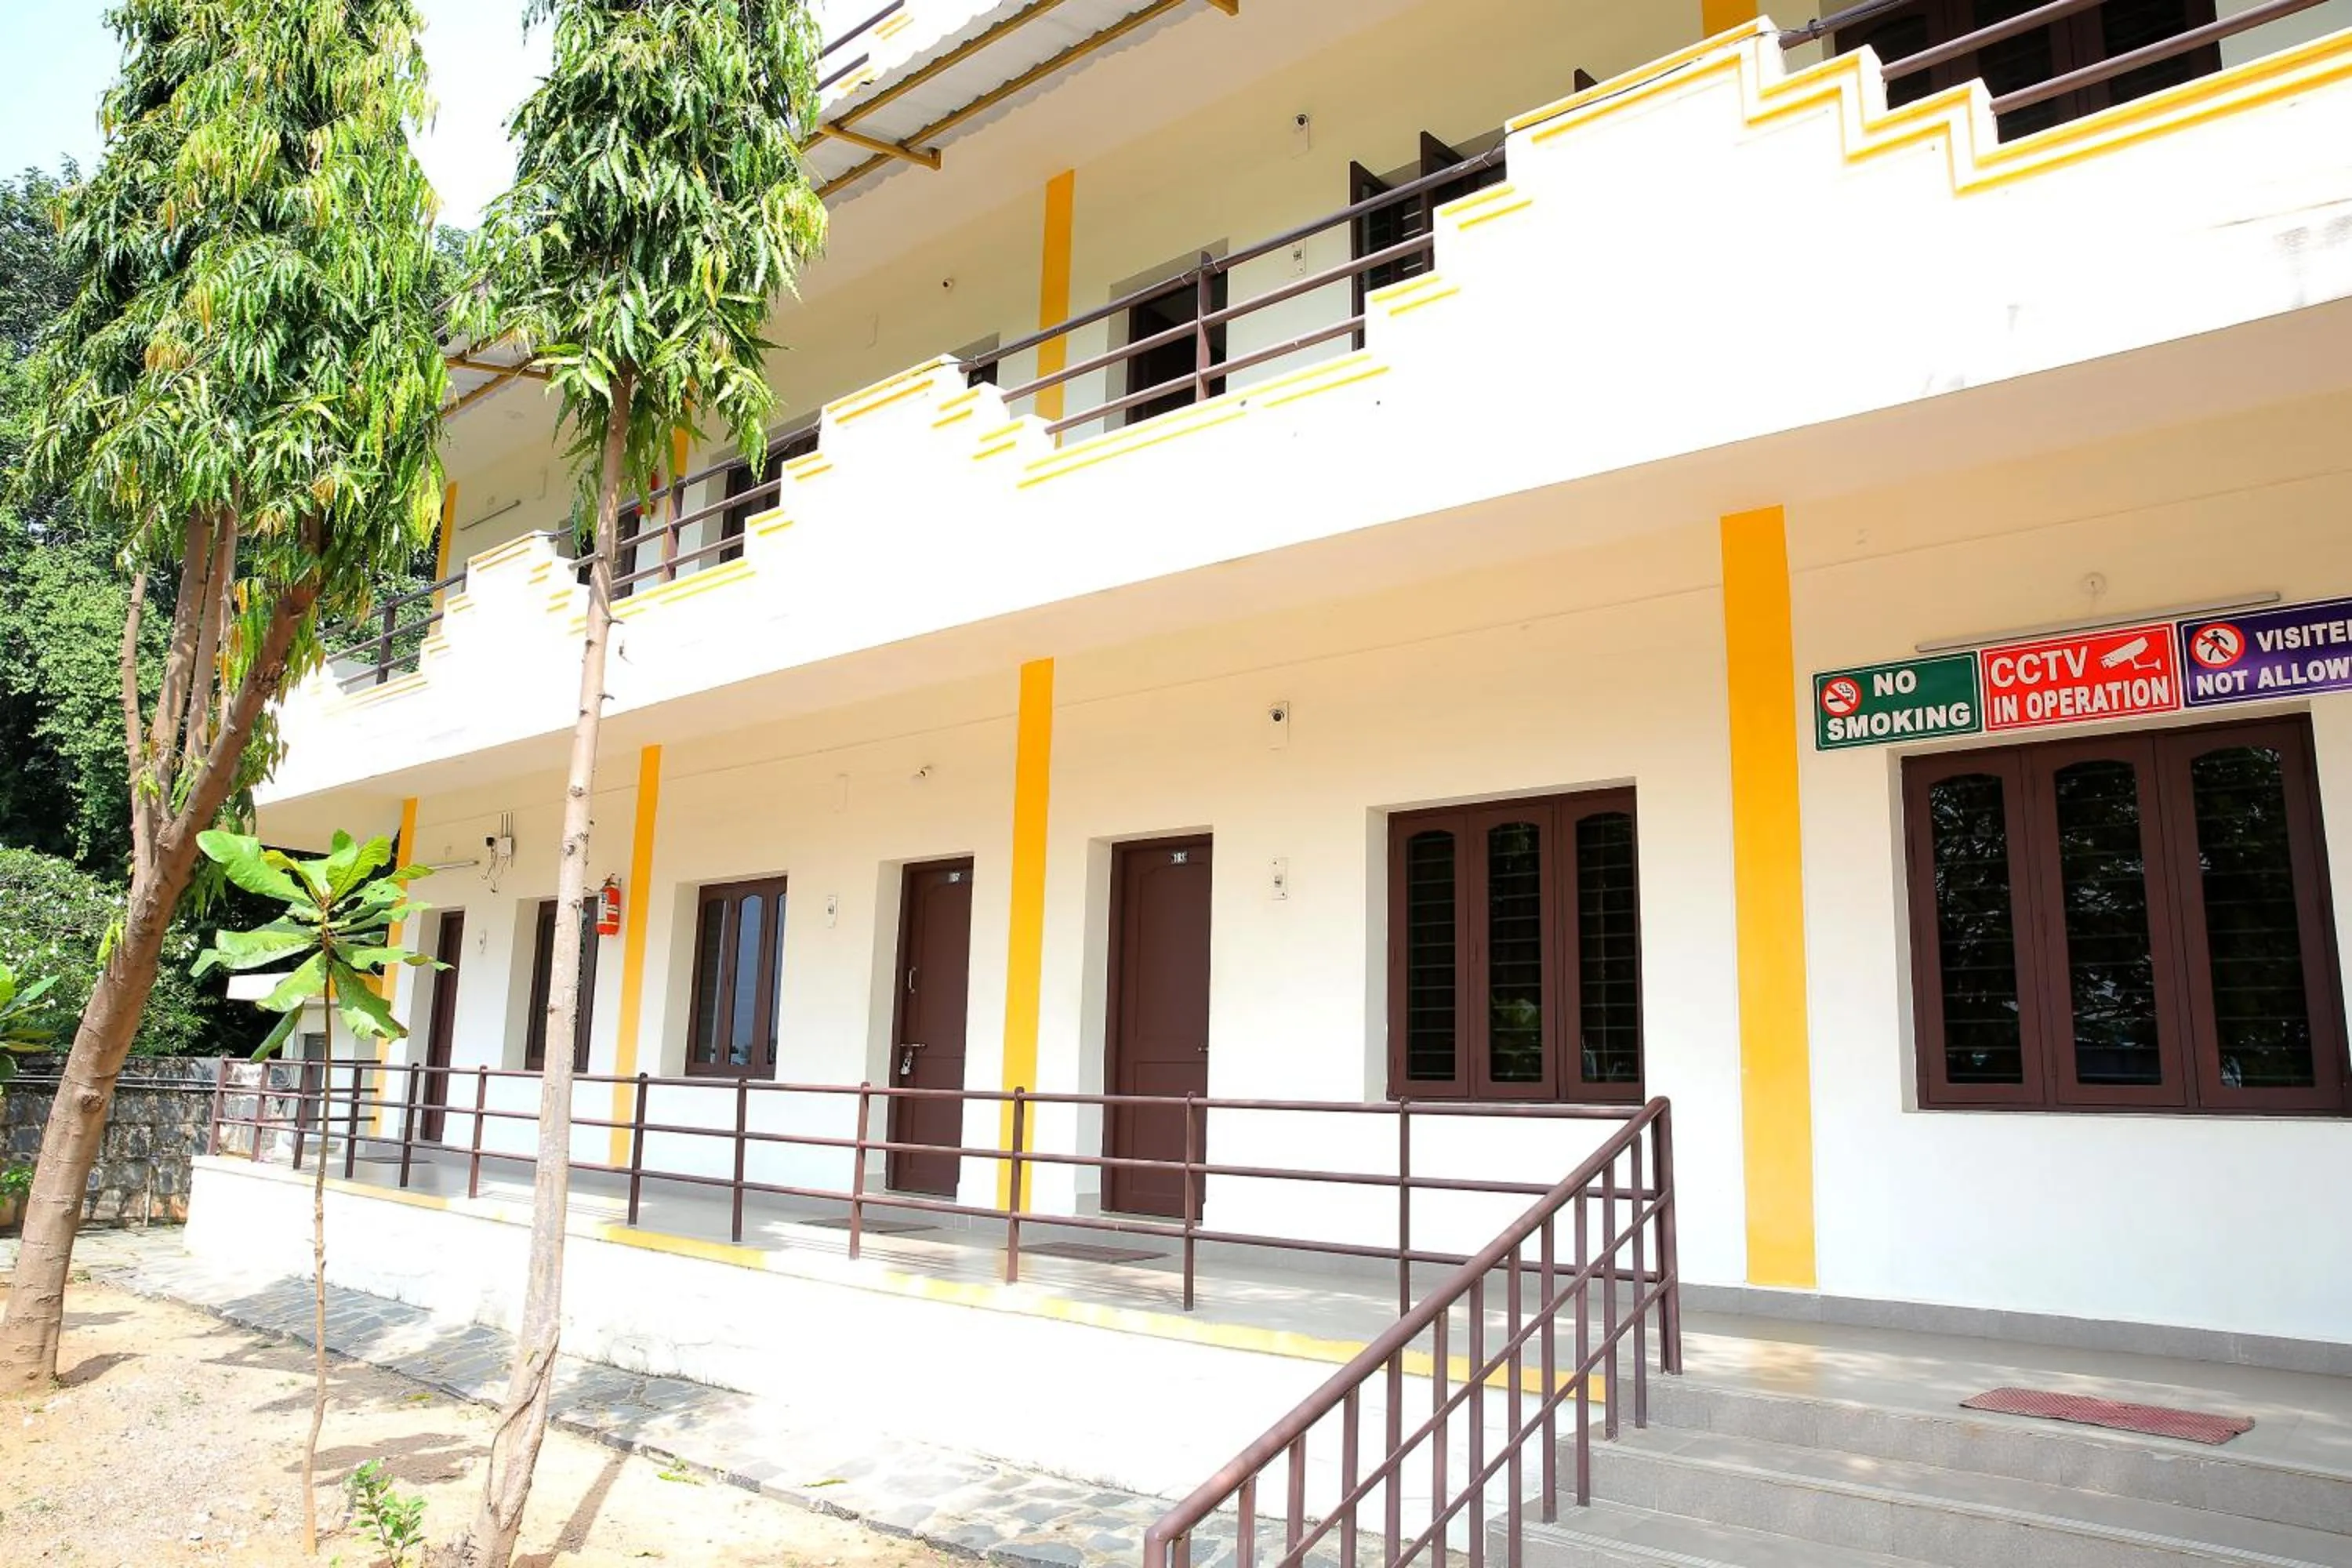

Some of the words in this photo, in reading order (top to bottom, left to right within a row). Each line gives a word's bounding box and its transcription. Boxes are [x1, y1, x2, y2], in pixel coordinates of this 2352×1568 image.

[1873, 670, 1917, 696] NO
[1991, 645, 2088, 688] CCTV
[2196, 670, 2249, 696] NOT
[2257, 656, 2352, 688] ALLOW
[1994, 695, 2019, 723] IN
[2026, 676, 2169, 720] OPERATION
[1828, 702, 1970, 740] SMOKING
